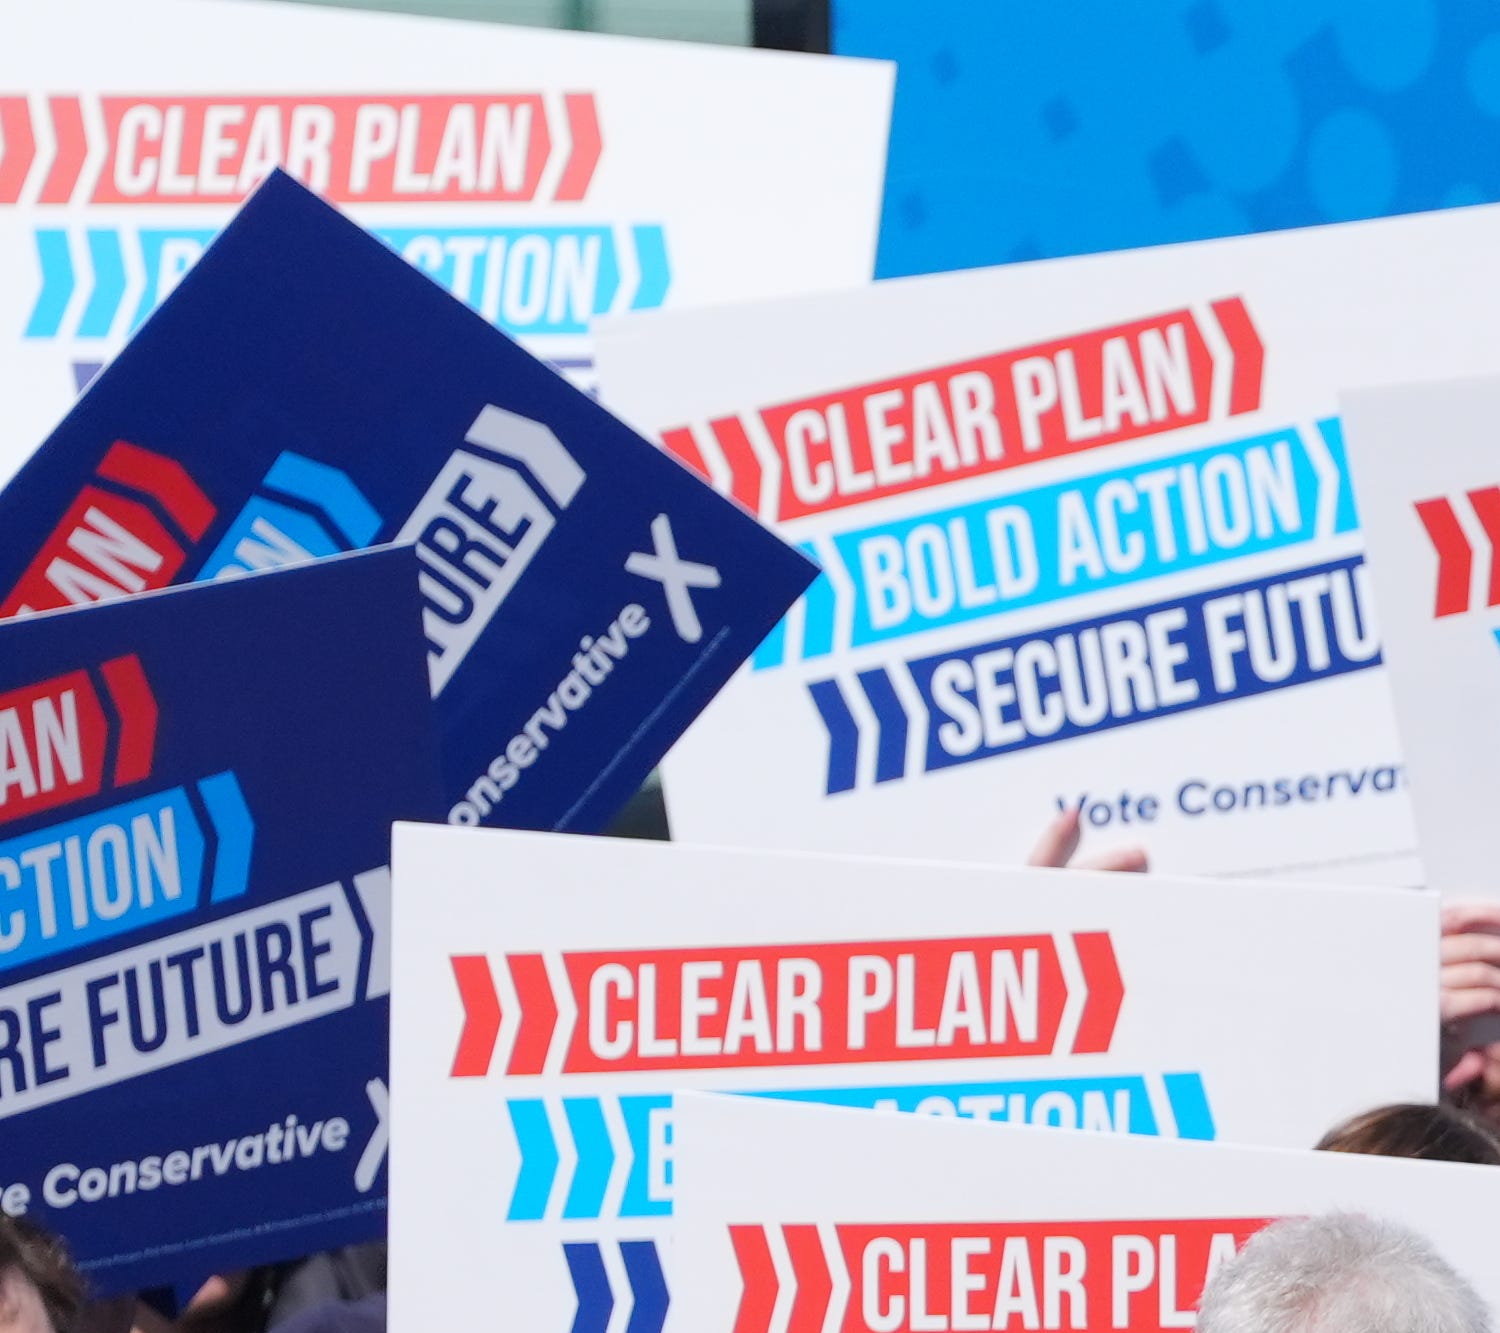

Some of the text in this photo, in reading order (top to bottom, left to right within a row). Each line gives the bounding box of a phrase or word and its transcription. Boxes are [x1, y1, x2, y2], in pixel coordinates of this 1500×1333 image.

[113, 101, 534, 196] CLEAR PLAN
[402, 235, 603, 323] TION
[783, 320, 1197, 506] CLEAR PLAN
[16, 505, 163, 615] AN
[415, 471, 534, 660] URE
[857, 440, 1302, 632] BOLD ACTION
[447, 602, 652, 826] onservative
[929, 562, 1383, 758] SECURE FUTU
[0, 688, 83, 806] AN
[1177, 764, 1403, 815] Conserva
[0, 806, 181, 952] CTION
[86, 906, 340, 1069] FUTURE
[588, 950, 1043, 1061] CLEAR PLAN
[43, 1114, 350, 1210] Conservative
[861, 1232, 1239, 1333] CLEAR PL
